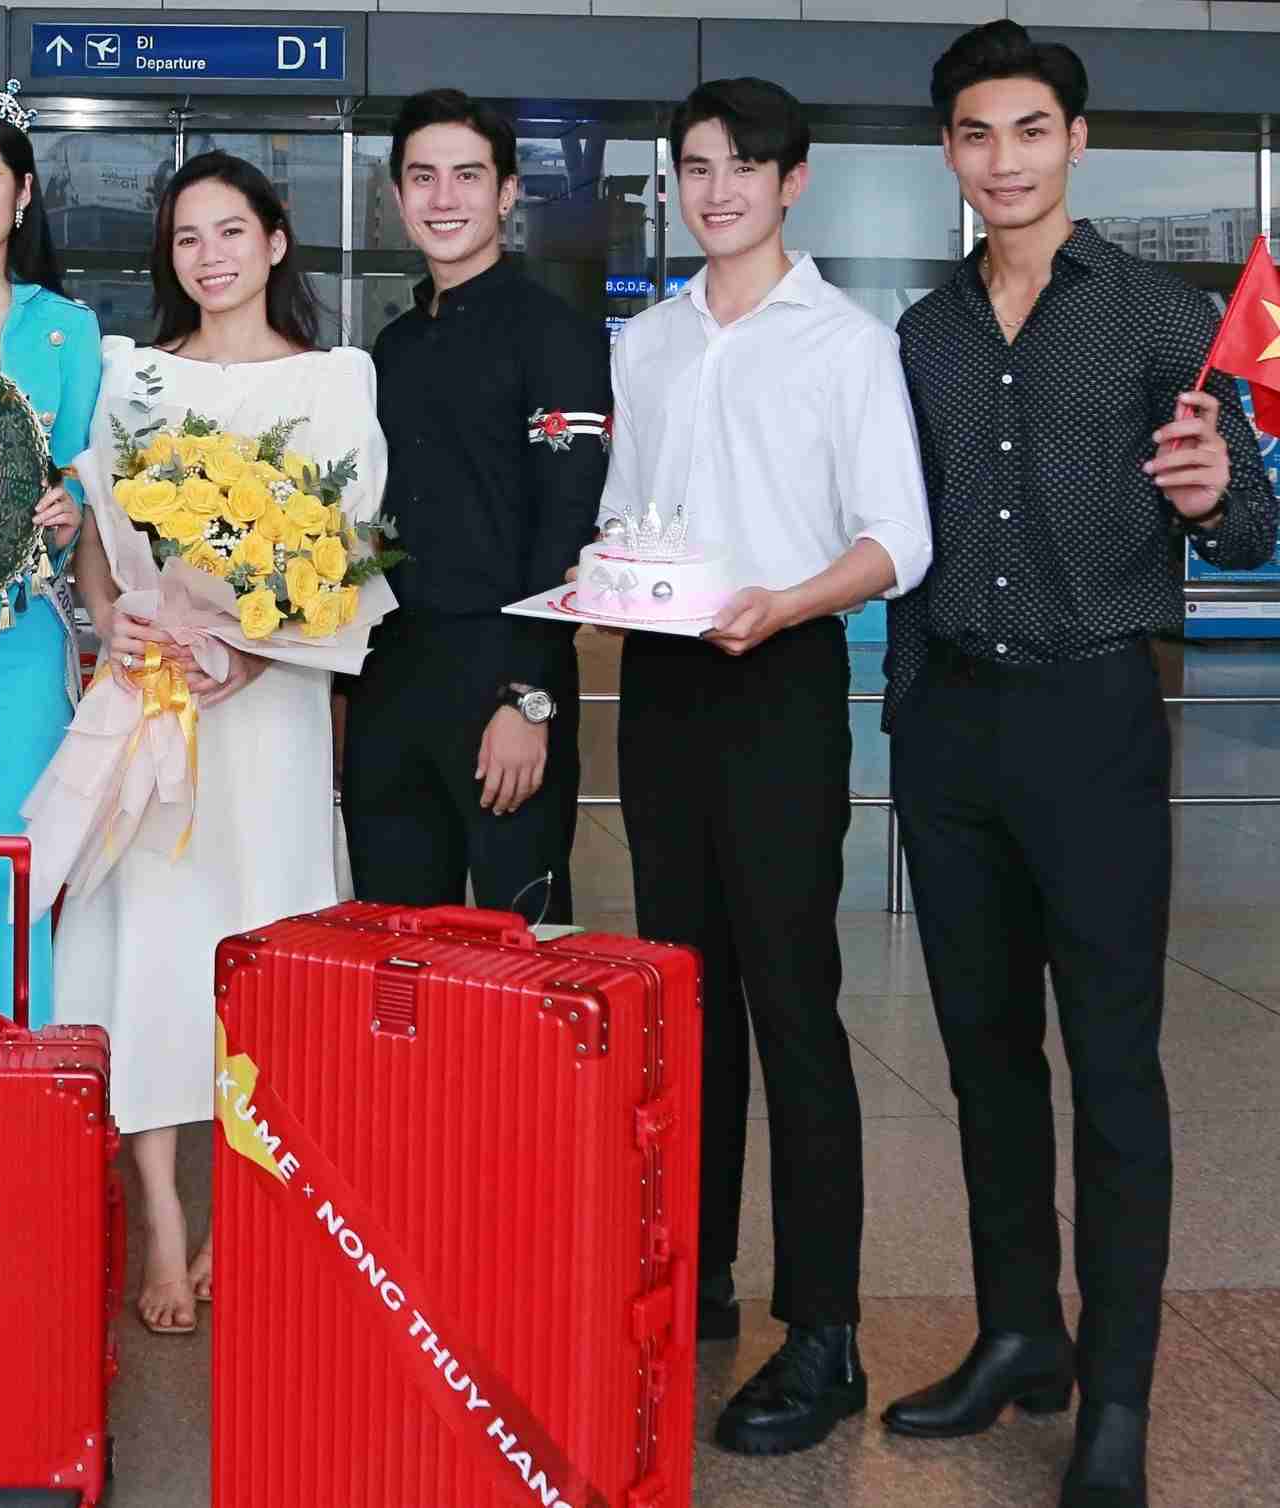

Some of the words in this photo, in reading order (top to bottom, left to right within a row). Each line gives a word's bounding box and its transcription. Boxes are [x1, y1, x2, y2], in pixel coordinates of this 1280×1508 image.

[136, 35, 153, 49] ĐI
[277, 35, 327, 70] D1
[136, 56, 206, 73] Departure
[215, 1067, 301, 1180] KUME
[316, 1201, 406, 1312] NONG
[409, 1310, 491, 1411] THUY
[486, 1416, 573, 1508] HAN
